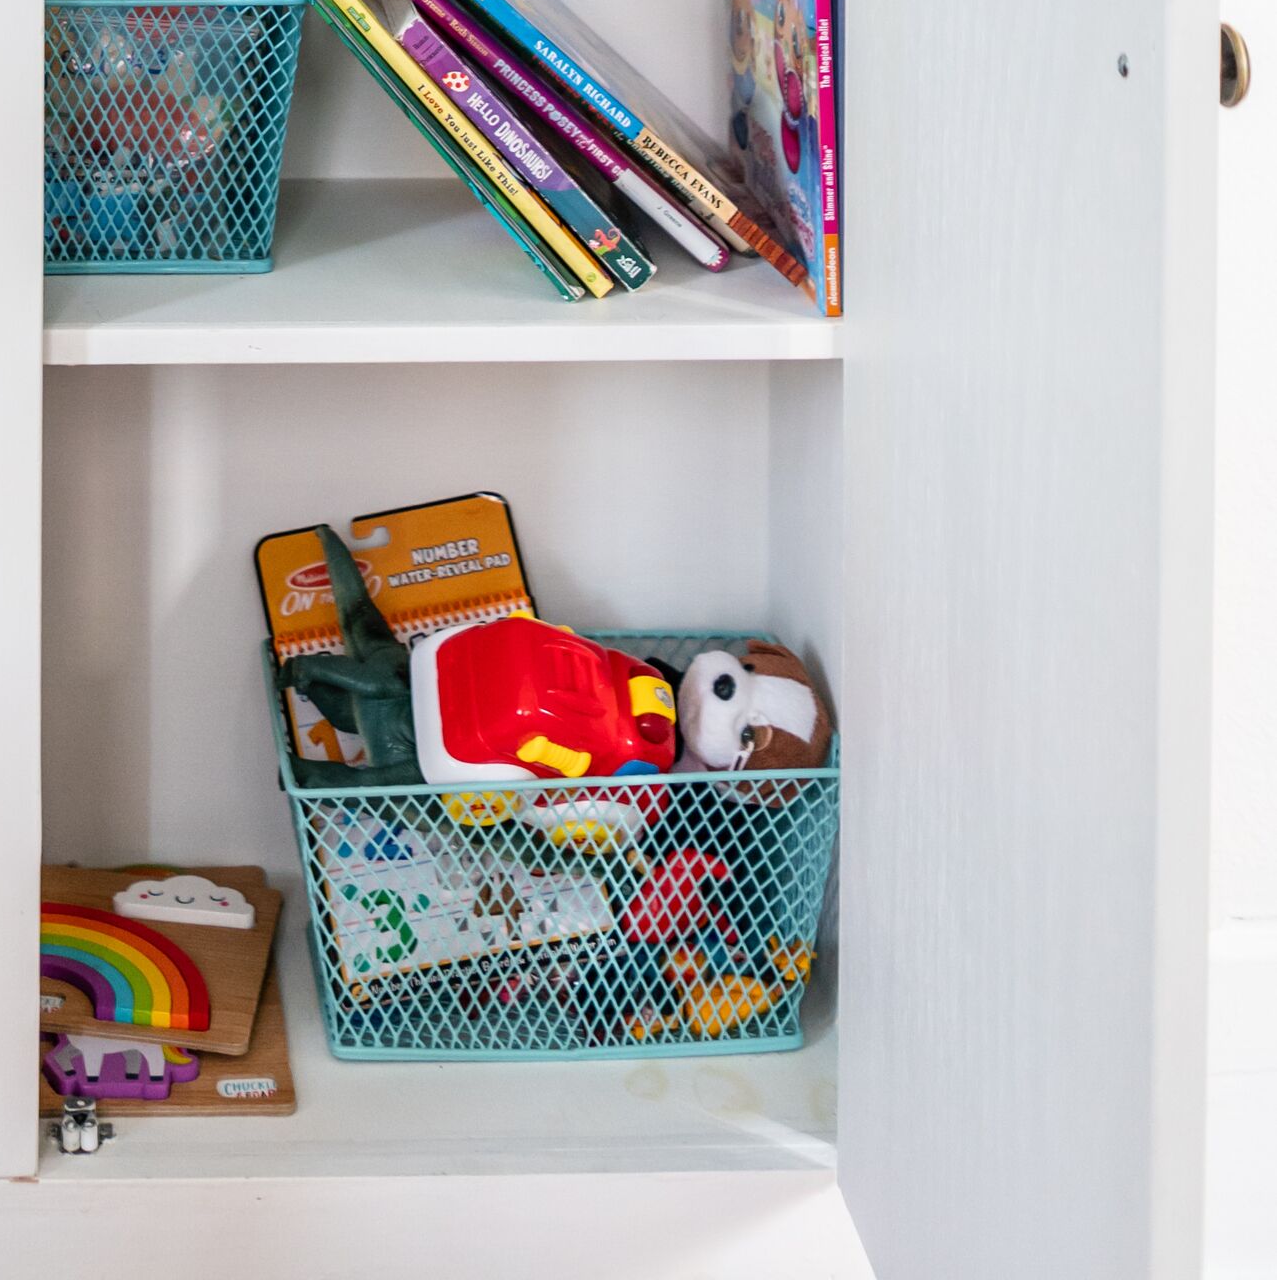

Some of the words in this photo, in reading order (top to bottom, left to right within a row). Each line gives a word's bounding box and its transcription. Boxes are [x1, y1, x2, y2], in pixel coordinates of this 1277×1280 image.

[449, 18, 468, 38] Roth
[467, 33, 489, 57] Sisson
[818, 18, 829, 40] Ballet
[819, 43, 832, 73] Magical
[534, 40, 584, 86] SARALYN
[582, 83, 632, 128] RICHARD
[819, 75, 831, 89] The
[493, 58, 548, 107] PRINCESS
[542, 102, 582, 137] POSEY
[587, 143, 614, 167] FIRST
[423, 91, 444, 114] Love
[445, 114, 460, 133] You
[460, 132, 478, 151] Just
[476, 150, 496, 172] Like
[497, 171, 519, 196] This!
[466, 92, 500, 126] HELLO
[494, 121, 553, 182] DINOSAURS!
[642, 135, 689, 180] REBECCA
[690, 178, 723, 209] EVANS
[823, 172, 834, 186] and
[663, 209, 683, 228] Greene
[824, 188, 836, 222] Shimmer
[827, 247, 838, 306] nickelodeon
[411, 538, 480, 566] NUMBER
[387, 559, 483, 588] WATER-REVEAL
[485, 553, 512, 569] PAD
[280, 590, 316, 616] ON
